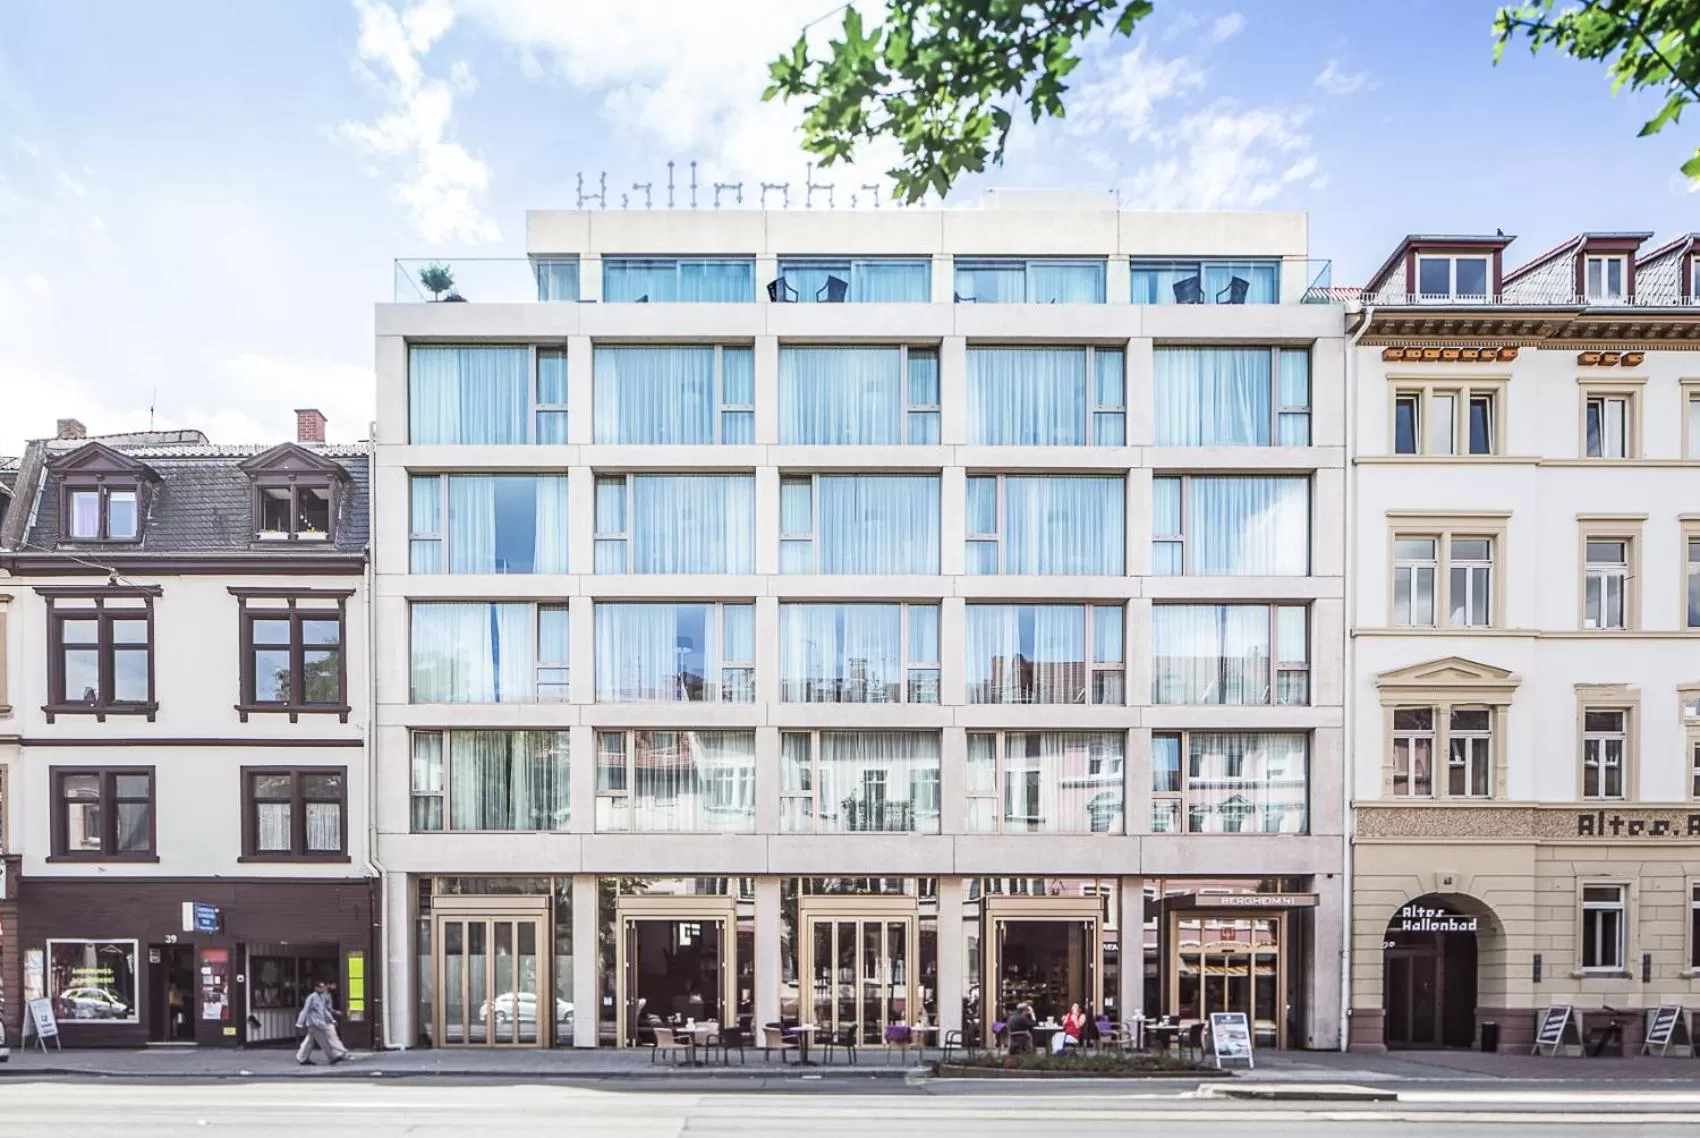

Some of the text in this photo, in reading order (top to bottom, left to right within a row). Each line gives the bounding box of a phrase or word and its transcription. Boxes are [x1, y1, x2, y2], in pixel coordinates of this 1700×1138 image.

[1402, 904, 1445, 918] Altes
[1402, 918, 1478, 931] Hallenbad
[164, 934, 178, 944] 39
